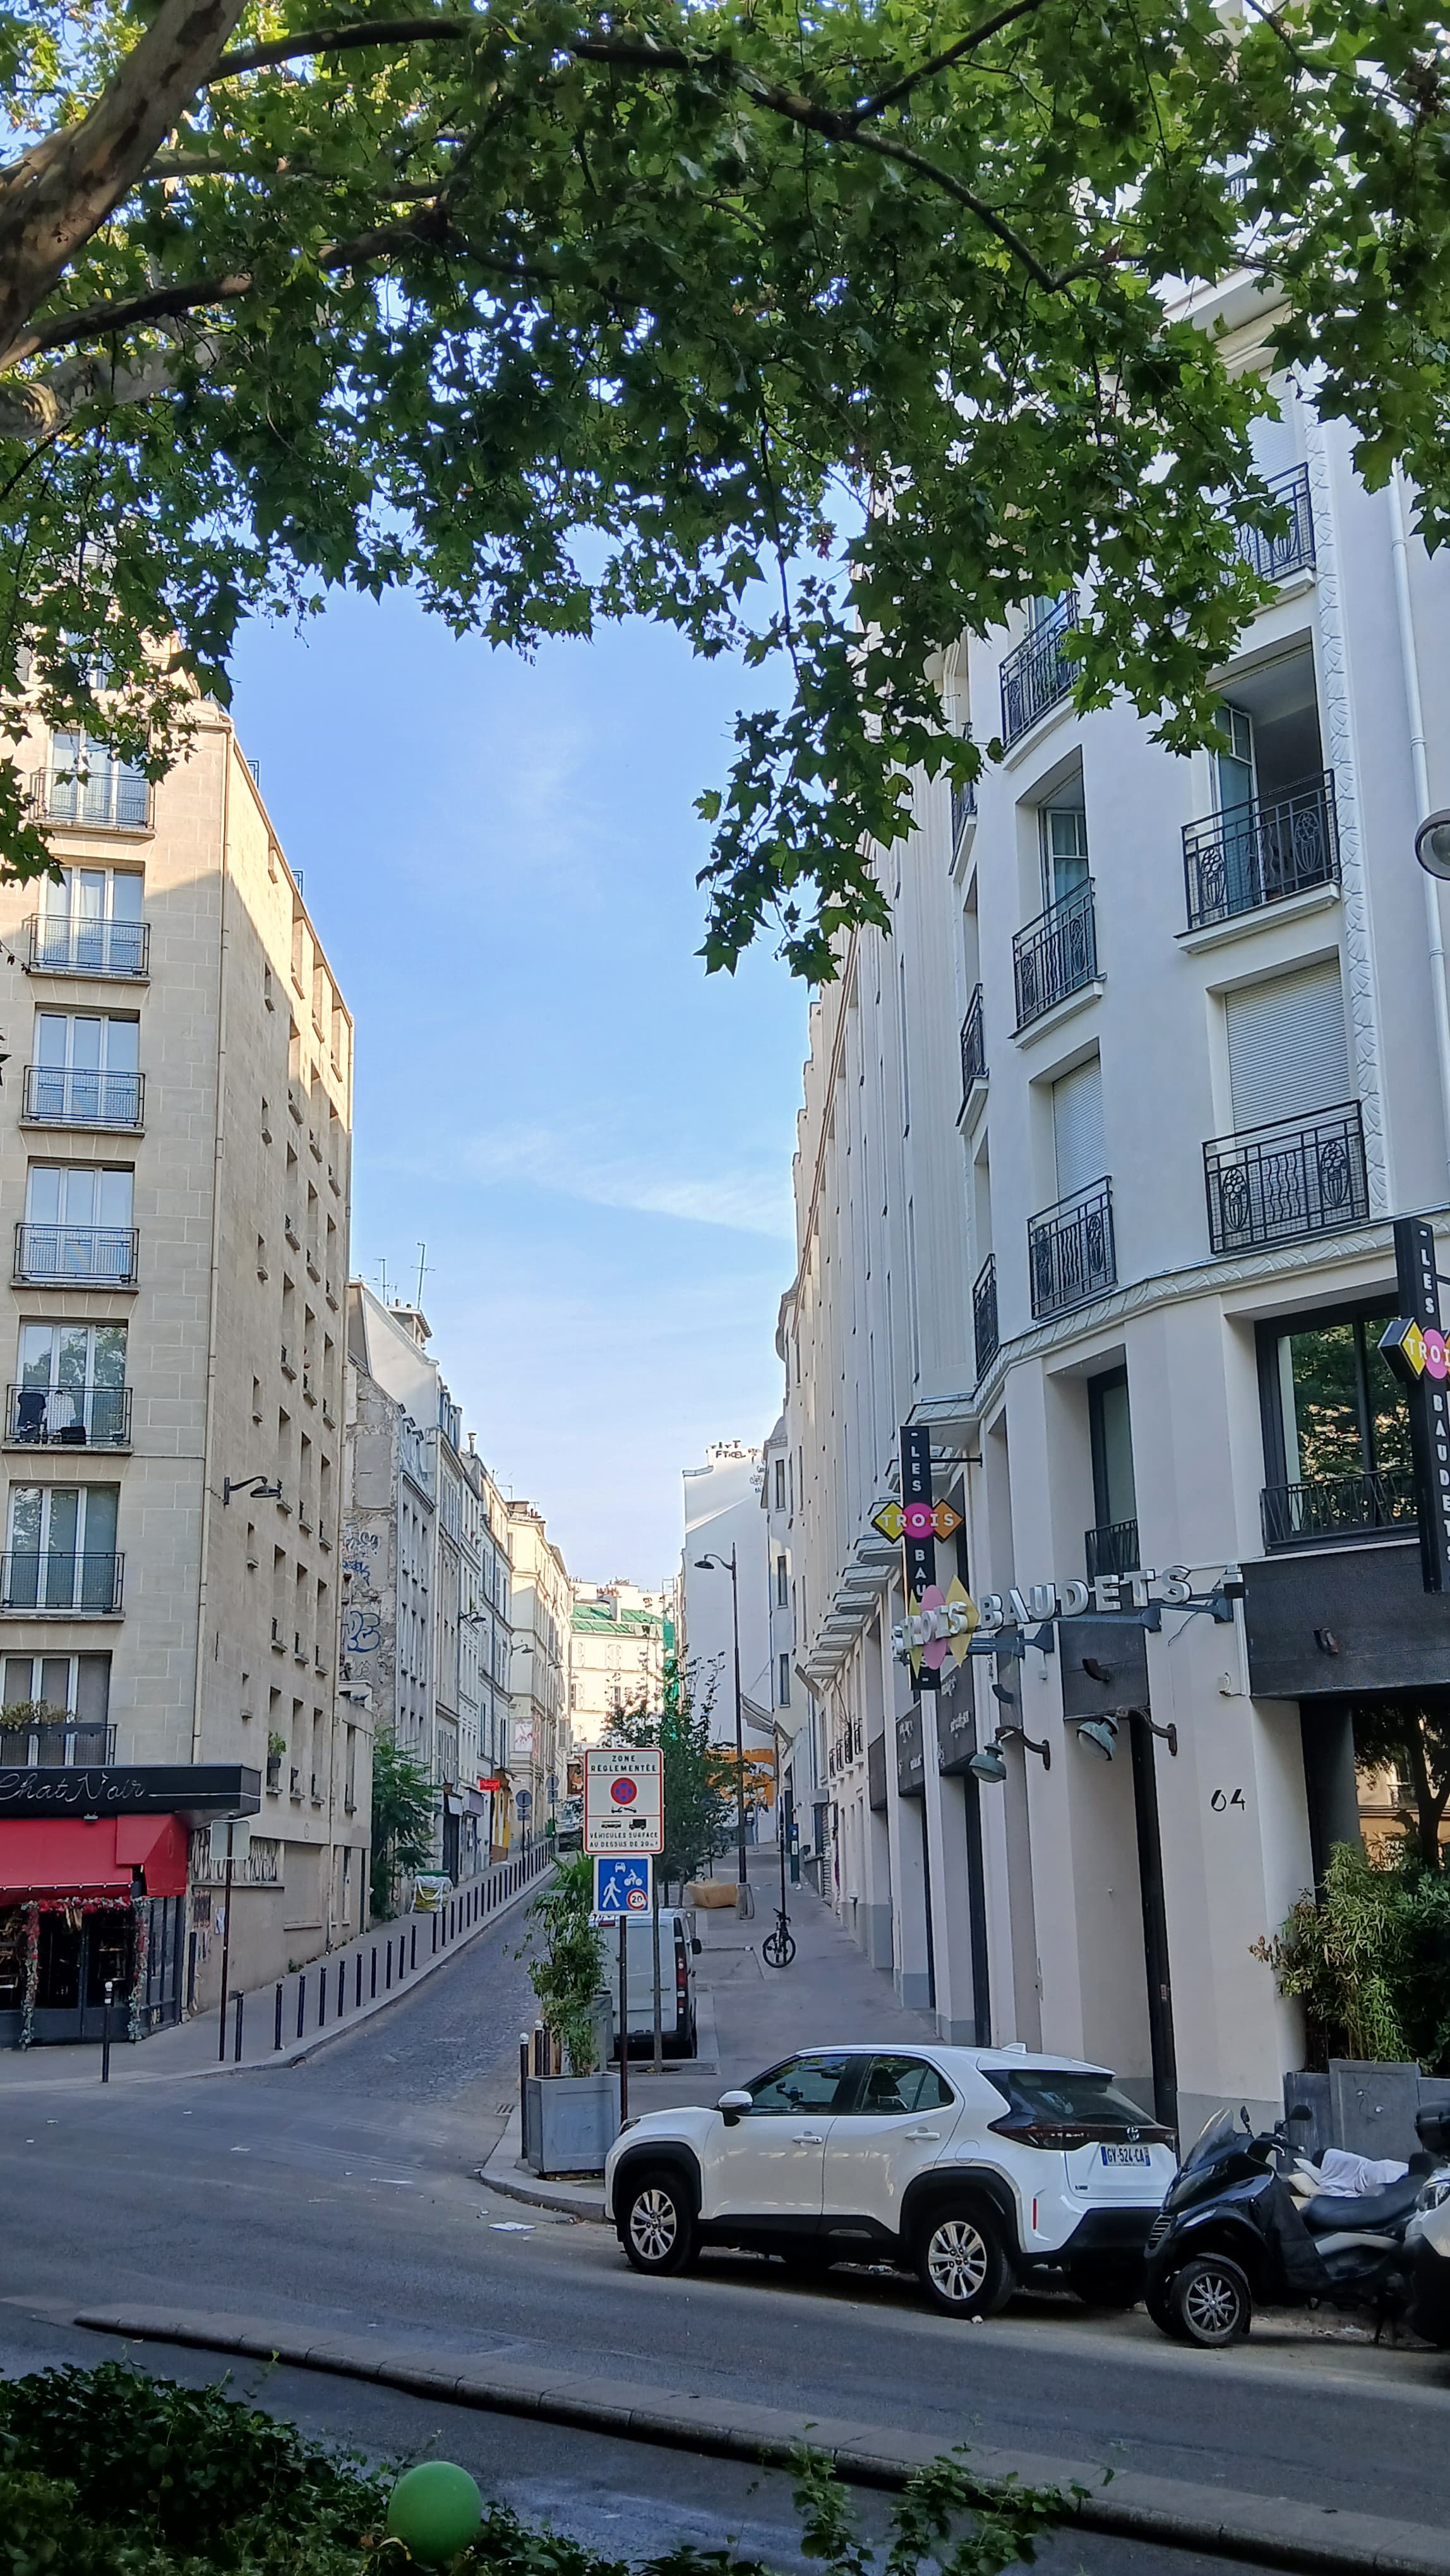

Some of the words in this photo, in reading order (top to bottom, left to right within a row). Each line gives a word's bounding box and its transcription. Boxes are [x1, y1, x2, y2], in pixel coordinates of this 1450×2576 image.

[1421, 1249, 1435, 1314] LES
[1406, 1337, 1450, 1366] TROI
[911, 1445, 921, 1492] LES
[880, 1513, 955, 1527] TROIS
[980, 1566, 1190, 1630] BAUDETS
[0, 1772, 69, 1800] Chat
[64, 1772, 145, 1802] Noir
[1211, 1788, 1246, 1812] 64
[632, 1895, 643, 1904] 20
